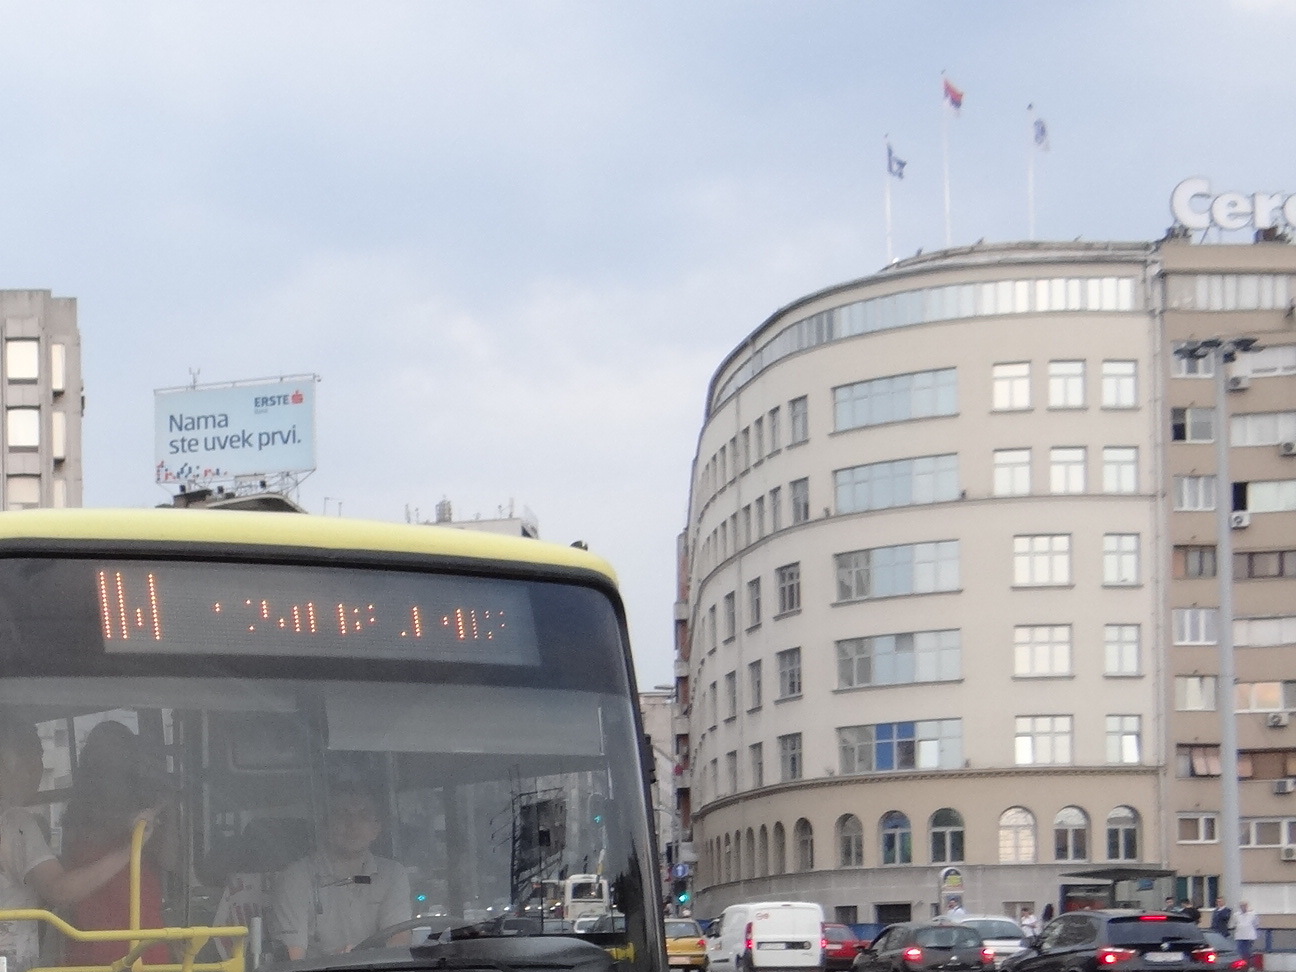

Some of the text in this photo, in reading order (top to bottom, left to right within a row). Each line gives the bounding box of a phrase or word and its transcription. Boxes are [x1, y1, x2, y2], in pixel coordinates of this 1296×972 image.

[254, 395, 289, 408] ERSTE
[169, 413, 229, 433] Nama
[169, 425, 301, 454] ste uvek prvi.
